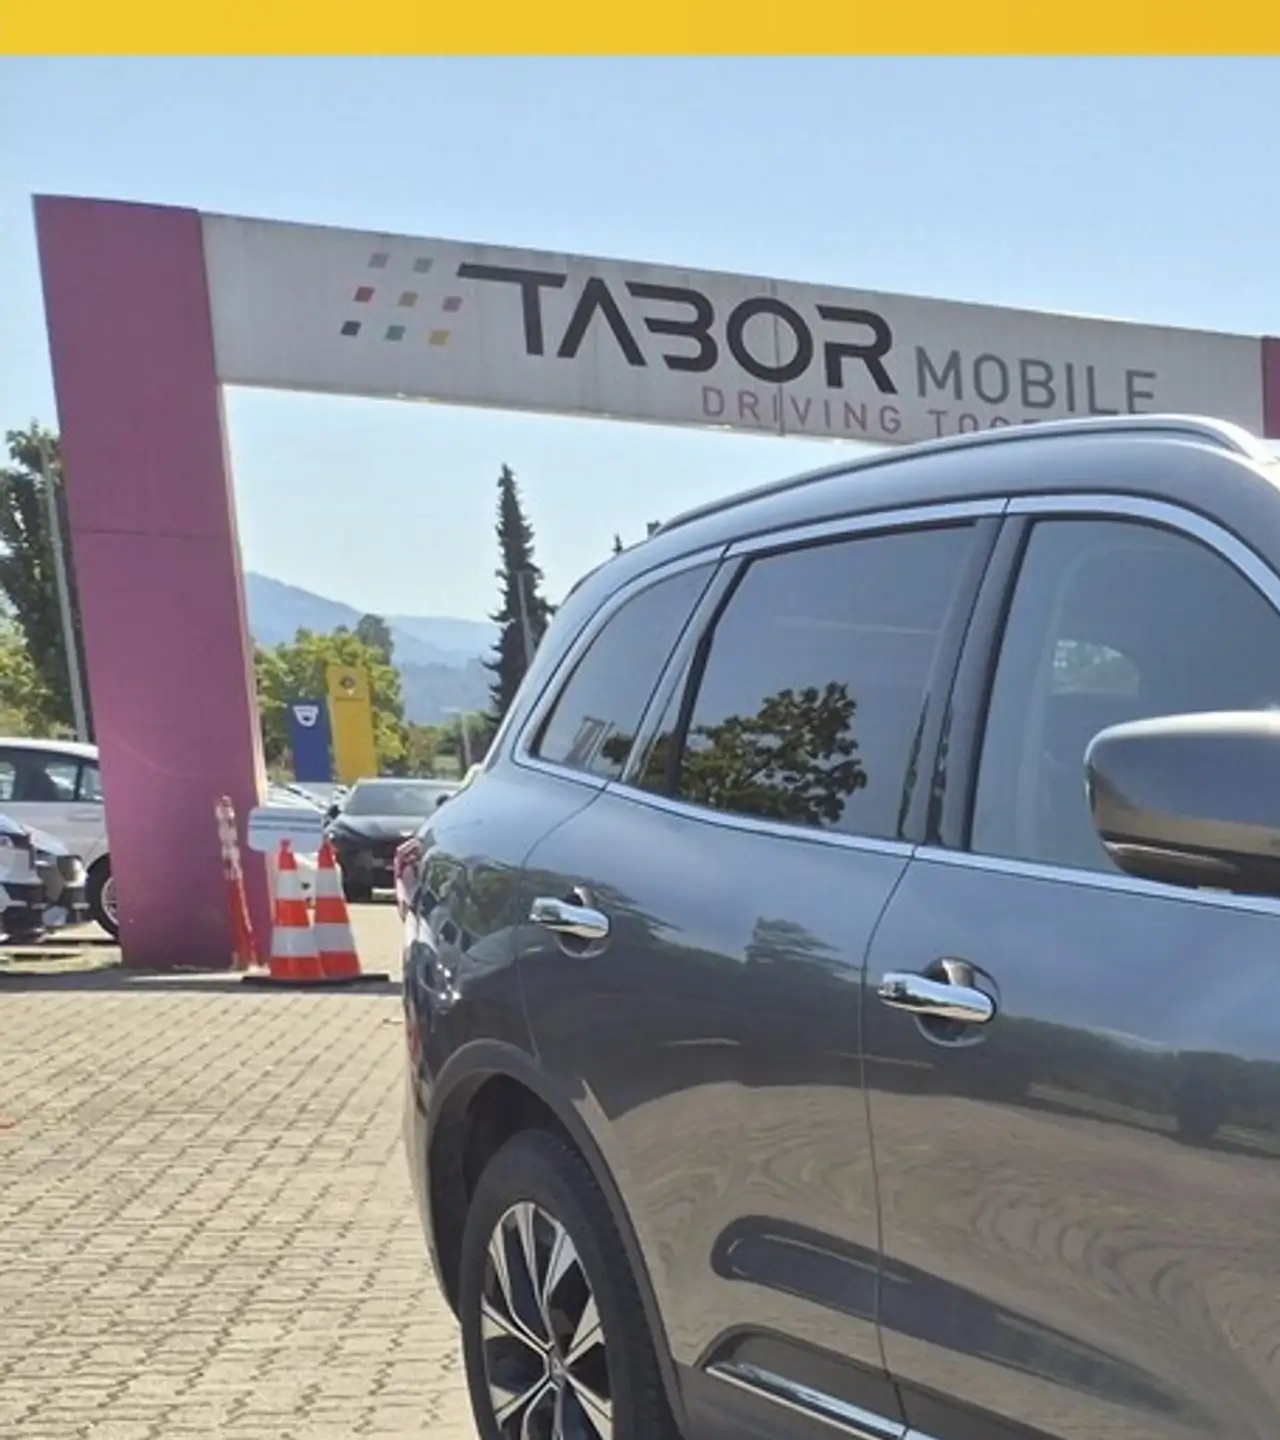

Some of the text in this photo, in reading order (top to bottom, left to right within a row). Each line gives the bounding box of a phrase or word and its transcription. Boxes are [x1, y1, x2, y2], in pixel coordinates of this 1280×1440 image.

[456, 262, 1158, 416] TABOR MOBILE
[702, 386, 901, 435] DRIVING
